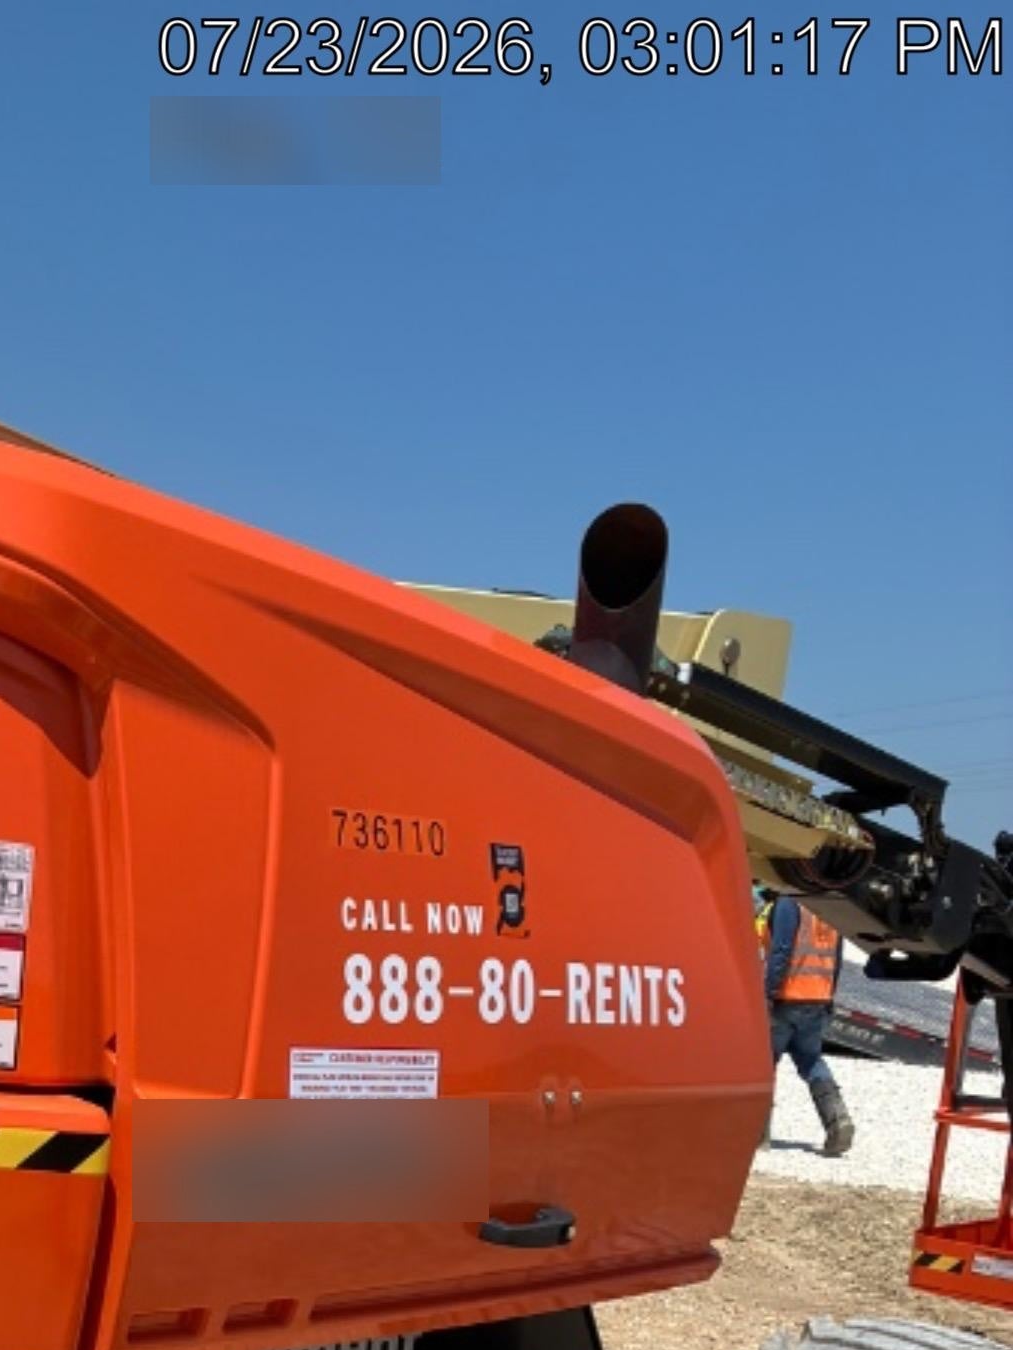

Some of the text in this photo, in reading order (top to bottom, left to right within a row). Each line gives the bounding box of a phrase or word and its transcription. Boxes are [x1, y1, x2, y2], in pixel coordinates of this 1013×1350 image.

[332, 809, 445, 857] 736110
[341, 896, 484, 936] CALL NOW
[342, 953, 686, 1027] 888-80-RENTS
